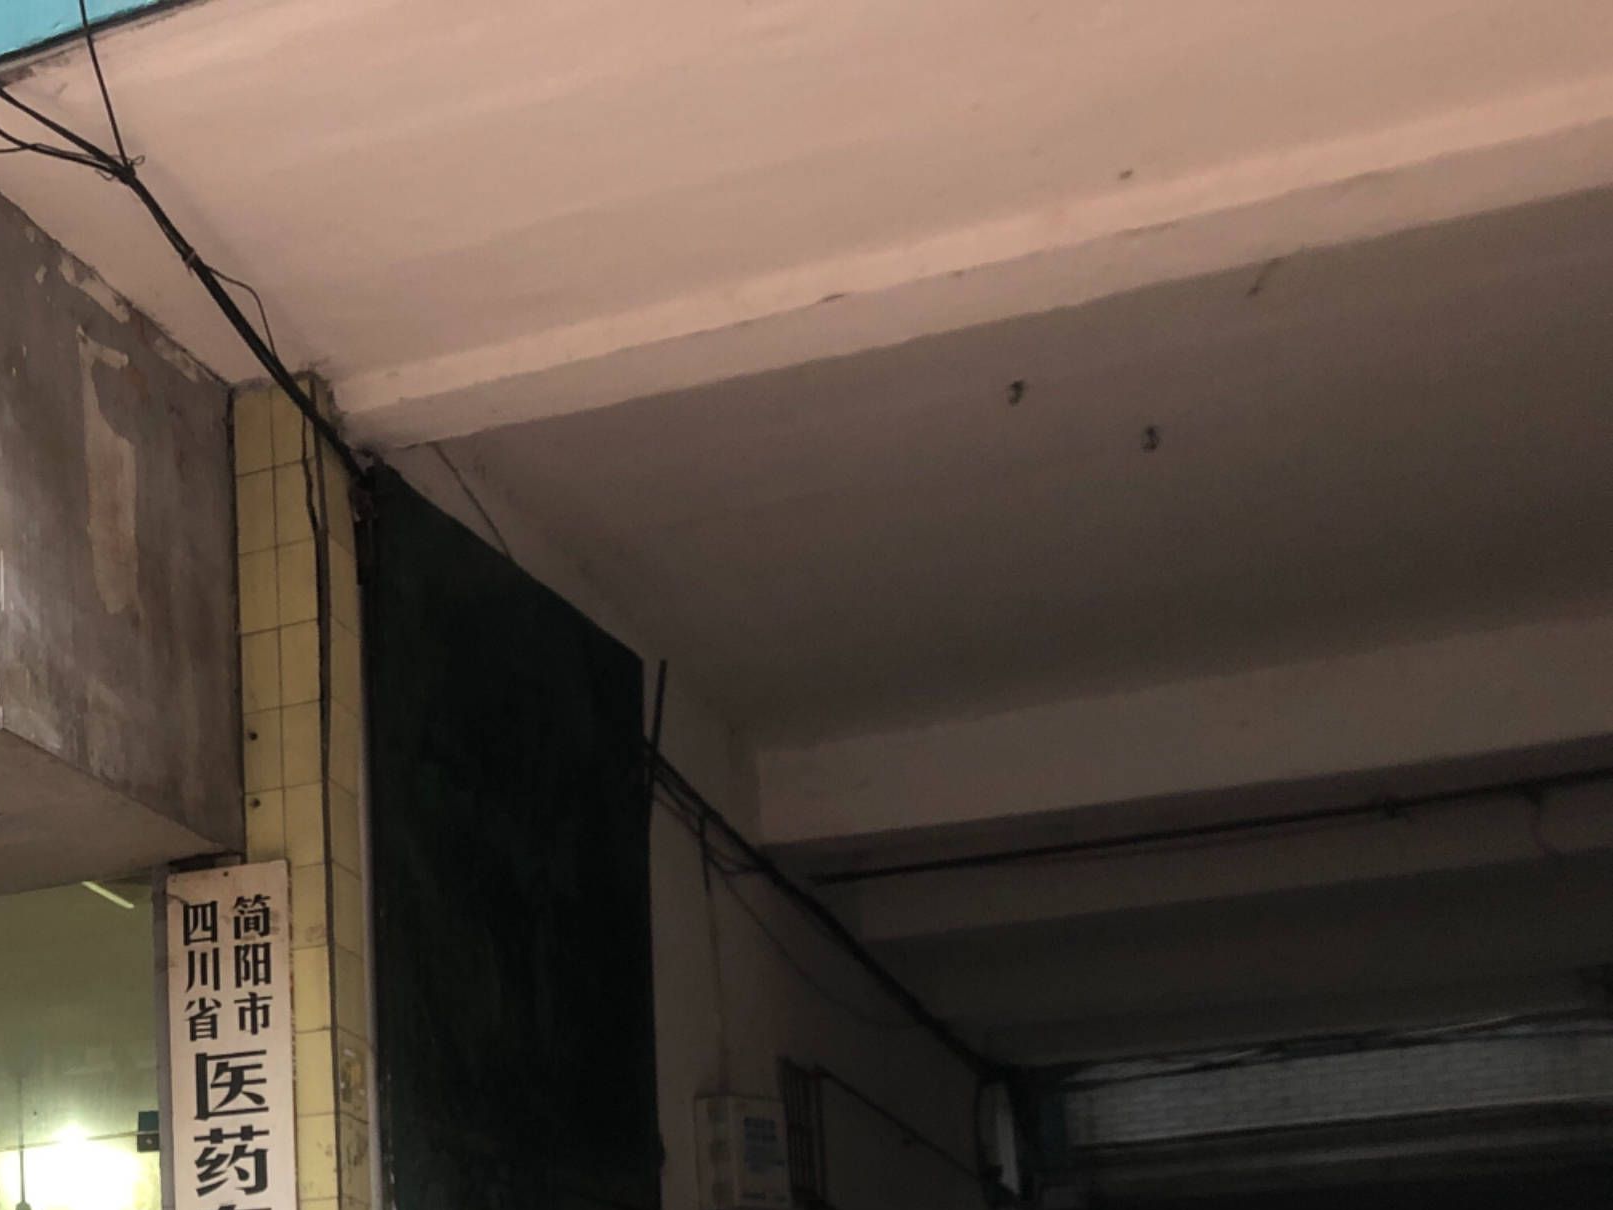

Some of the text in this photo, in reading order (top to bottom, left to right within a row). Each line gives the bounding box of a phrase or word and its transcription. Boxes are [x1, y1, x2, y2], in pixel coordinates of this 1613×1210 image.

[182, 900, 222, 1042] 四川省
[233, 895, 274, 1036] 简阳市
